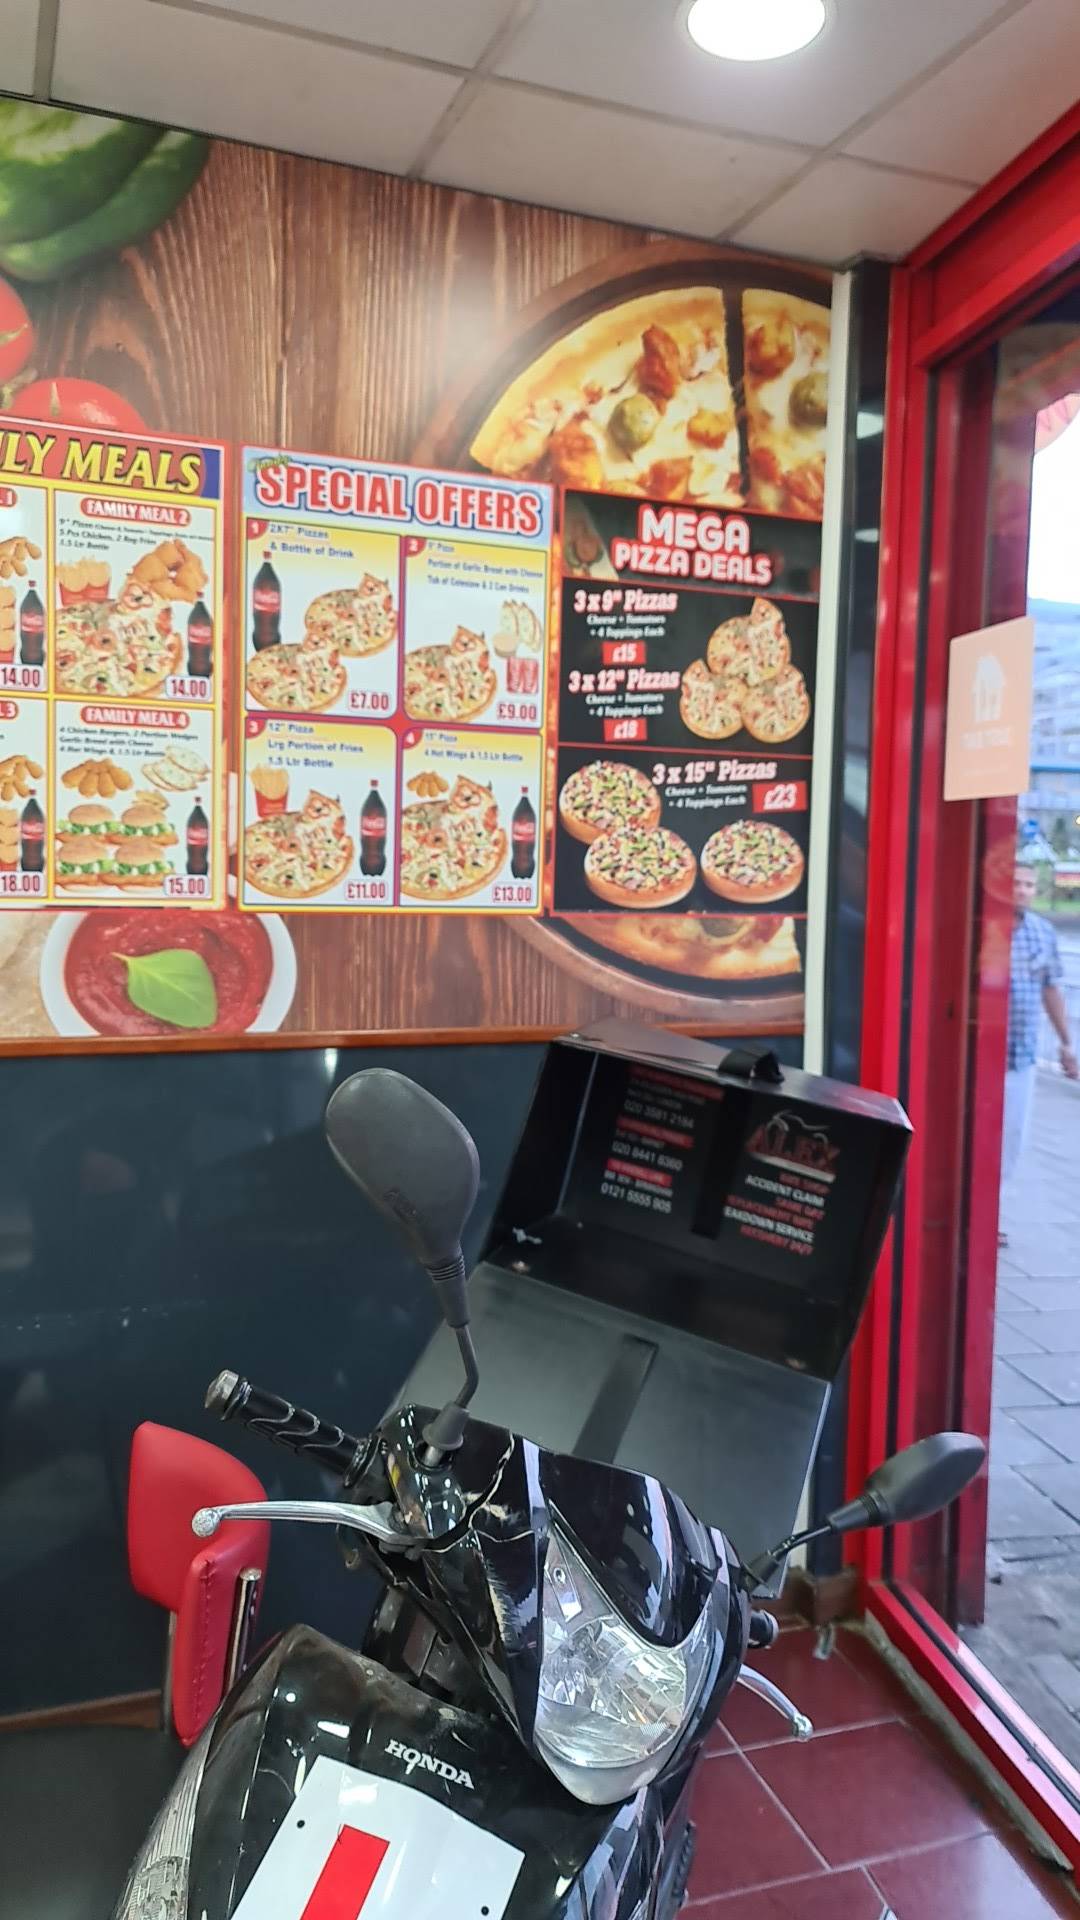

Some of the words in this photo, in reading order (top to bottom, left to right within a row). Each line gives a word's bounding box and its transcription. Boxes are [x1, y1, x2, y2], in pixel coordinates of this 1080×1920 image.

[0, 430, 57, 477] LY
[61, 437, 202, 495] MEALS
[258, 462, 411, 520] SPECIAL
[416, 479, 541, 535] OFFERS
[86, 499, 136, 519] FAMILY
[139, 505, 176, 523] MEAL
[178, 510, 188, 524] 2
[641, 508, 750, 554] MEGA
[281, 542, 312, 555] Bottle
[315, 545, 325, 556] of
[329, 547, 355, 559] Drink
[408, 538, 419, 552] 2
[613, 542, 691, 577] PIZZA
[693, 552, 773, 586] DEALS
[574, 590, 587, 613] 3
[587, 592, 601, 612] x
[623, 588, 679, 613] Pizzas
[586, 614, 617, 625] Cheese
[597, 626, 605, 637] 4
[606, 626, 643, 639] Toppings
[644, 626, 666, 637] Each
[612, 645, 637, 663] £15
[171, 679, 208, 698] 14.00
[567, 670, 581, 692] 3
[581, 672, 596, 692] x
[626, 668, 681, 691] Pizzas
[350, 692, 390, 711] £7.00
[585, 693, 615, 704] Cheese
[85, 707, 136, 724] FAMILY
[137, 711, 175, 726] MEAL
[499, 702, 537, 721] £9.00
[596, 705, 604, 716] 4
[605, 705, 642, 718] Toppings
[642, 704, 664, 715] Each
[249, 720, 259, 734] 3
[288, 723, 314, 735] Pizza
[268, 739, 285, 751] Lrg
[287, 740, 324, 751] Portion
[327, 743, 337, 752] of
[340, 743, 364, 753] Fries
[286, 757, 301, 767] Ltr
[303, 757, 335, 768] Bottle
[651, 763, 666, 786] 3
[666, 766, 682, 785] x
[716, 759, 778, 782] Pizzas
[664, 785, 696, 797] Cheese
[763, 783, 798, 811] £23
[676, 799, 683, 808] 4
[685, 797, 724, 810] Toppings
[724, 796, 747, 806] Each
[0, 873, 41, 893] 18.00
[168, 876, 206, 895] 15.00
[348, 882, 386, 900] £11.00
[493, 885, 532, 902] £13.00
[600, 1182, 625, 1198] 0121
[744, 1174, 793, 1199] ACCIDENT
[791, 1188, 826, 1208] CLAIM
[774, 1220, 816, 1244] SERVICE
[384, 1739, 475, 1790] HONDA
